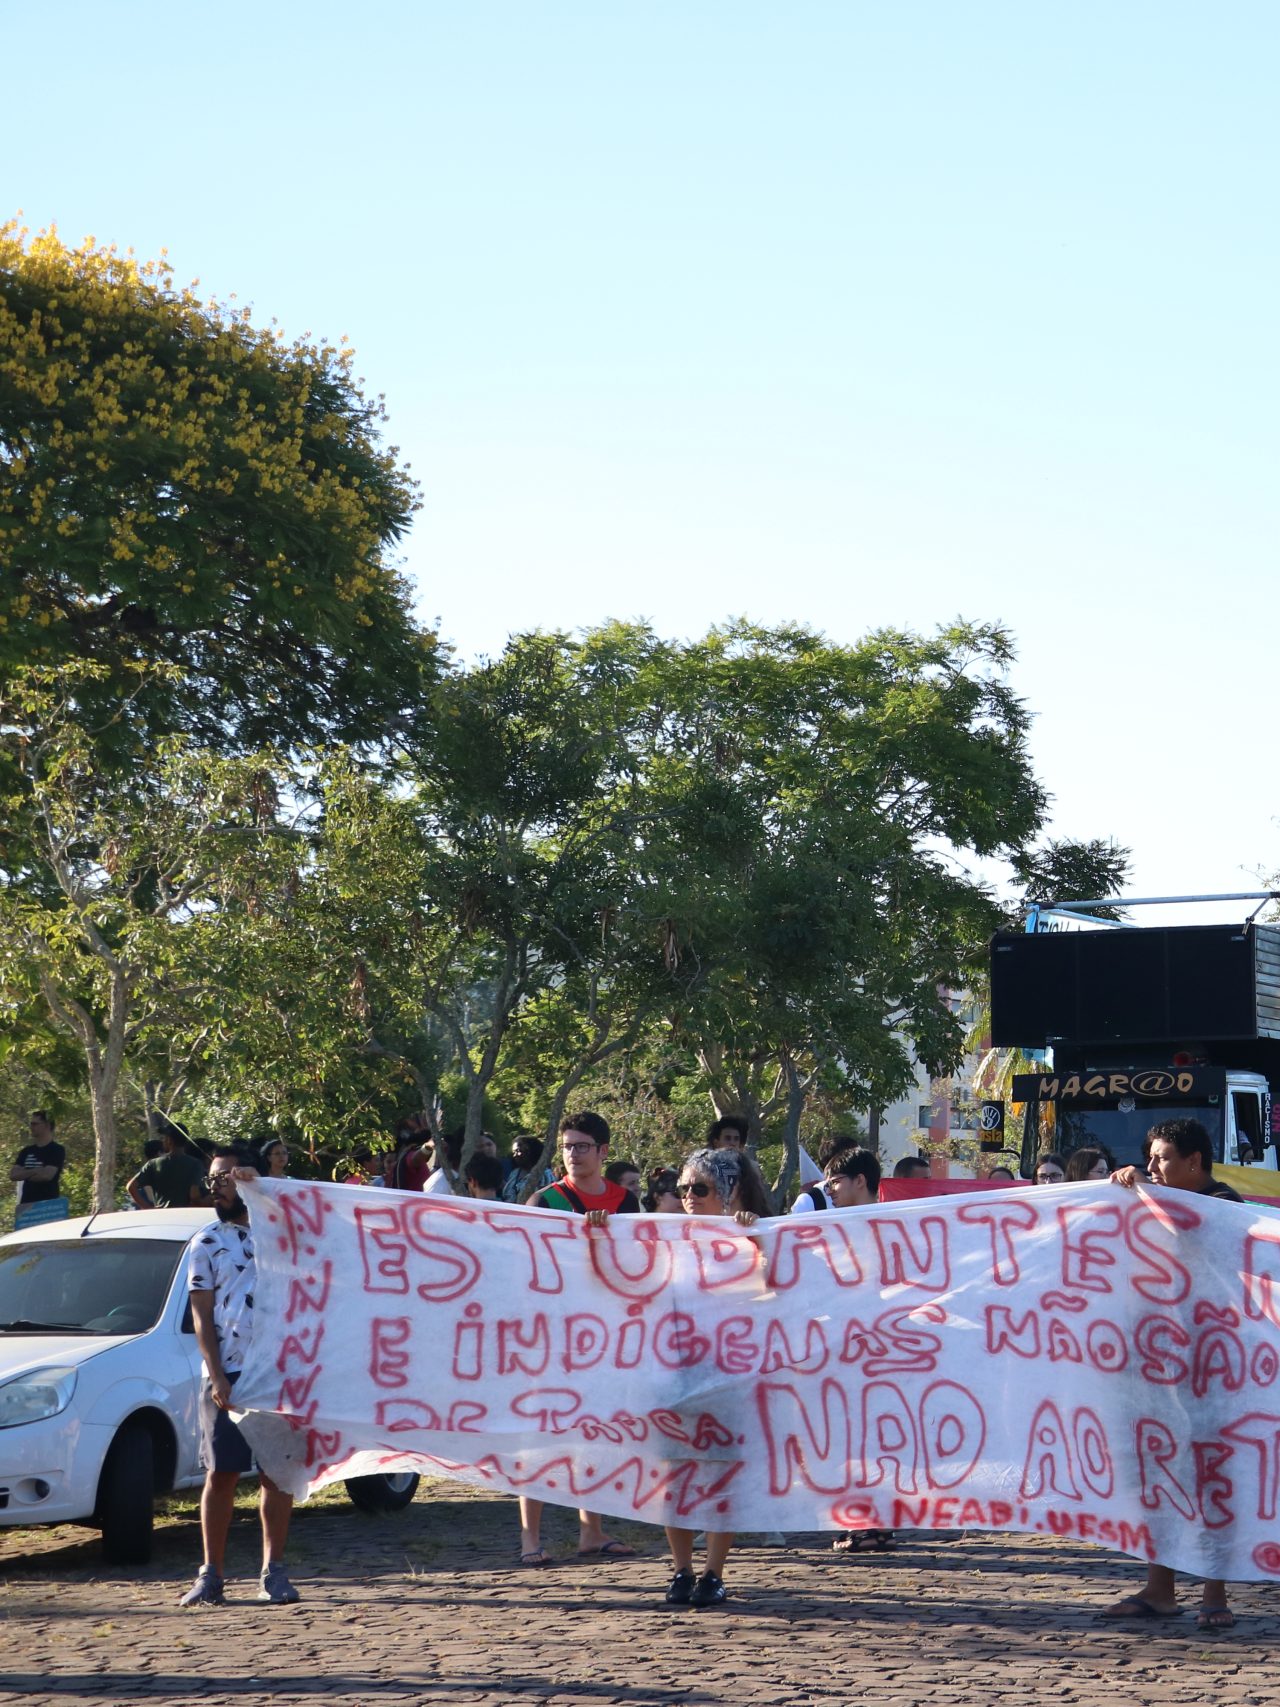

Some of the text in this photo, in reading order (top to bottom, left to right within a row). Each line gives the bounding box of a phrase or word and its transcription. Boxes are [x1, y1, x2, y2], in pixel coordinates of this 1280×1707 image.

[354, 1198, 1203, 1306] ESTUDANTES
[370, 1317, 411, 1388] E
[985, 1291, 1129, 1373] NÃO
[1134, 1302, 1279, 1398] SÃO
[1018, 1399, 1115, 1501] AO
